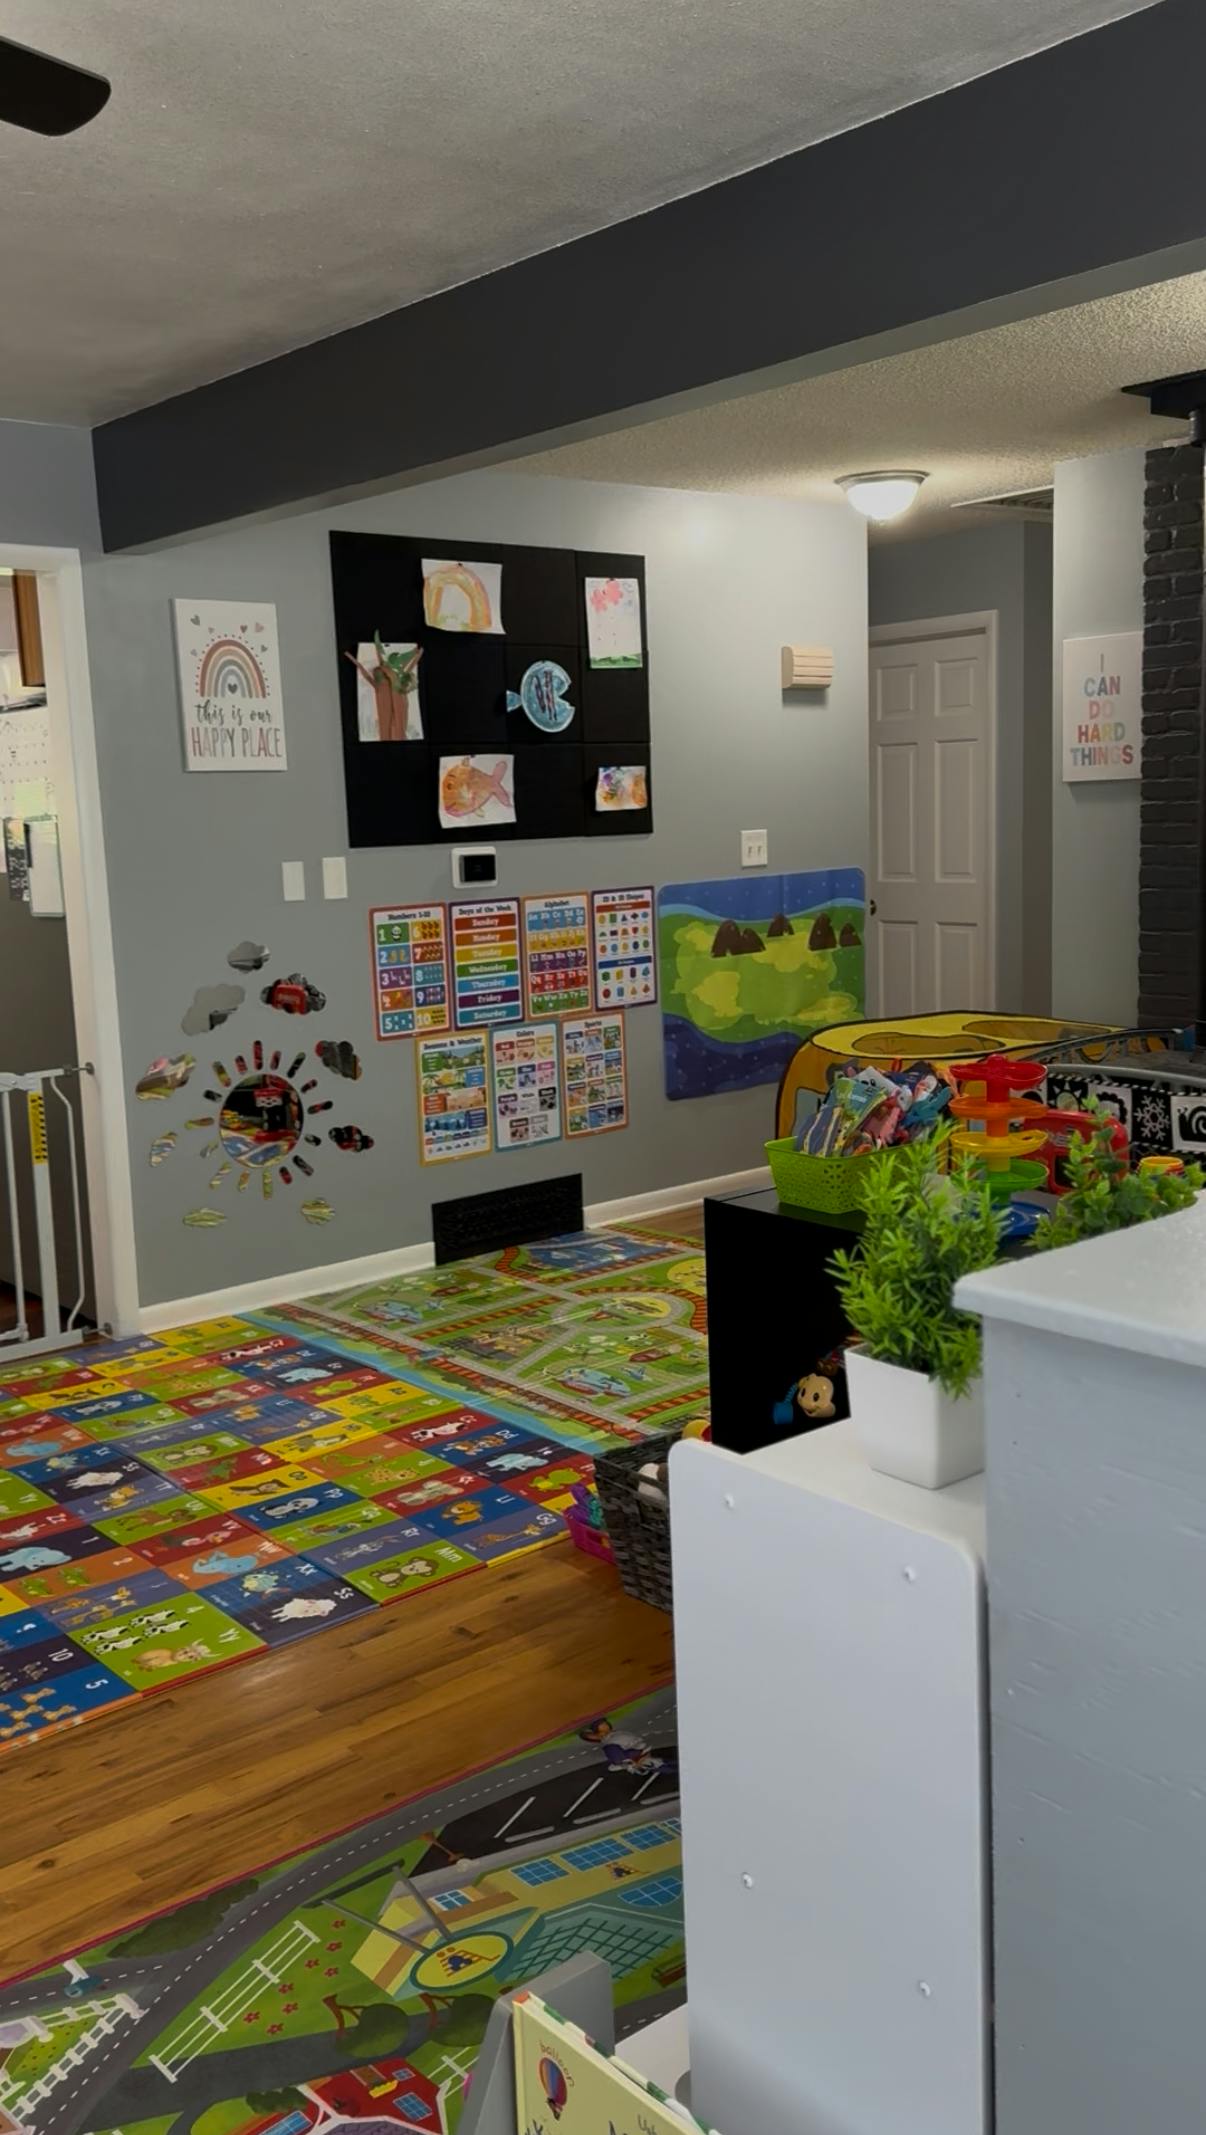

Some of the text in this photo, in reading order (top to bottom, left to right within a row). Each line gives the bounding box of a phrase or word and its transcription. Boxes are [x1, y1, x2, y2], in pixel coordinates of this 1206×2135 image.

[1100, 653, 1105, 672] I
[1084, 676, 1120, 697] CAN
[194, 700, 272, 726] this is our
[1089, 700, 1115, 720] DO
[1078, 722, 1126, 743] HARD
[191, 727, 283, 758] HAPPY PLACE
[1071, 744, 1134, 766] THINGS
[388, 912, 416, 921] Numbers
[472, 918, 499, 928] Sunday
[378, 928, 386, 941] 1
[472, 934, 500, 943] Monday
[379, 951, 387, 963] 2
[414, 947, 422, 960] 7
[468, 964, 507, 974] Wednesday
[381, 973, 389, 986] 3
[415, 970, 423, 982] 8
[472, 979, 506, 989] Thursday
[416, 991, 424, 1004] 9
[477, 994, 502, 1004] Friday
[416, 1013, 431, 1025] 10
[474, 1010, 507, 1021] Saturday
[384, 1018, 393, 1031] 5
[48, 1647, 74, 1662] 10
[85, 1678, 109, 1690] 5
[538, 2039, 575, 2088] balloon
